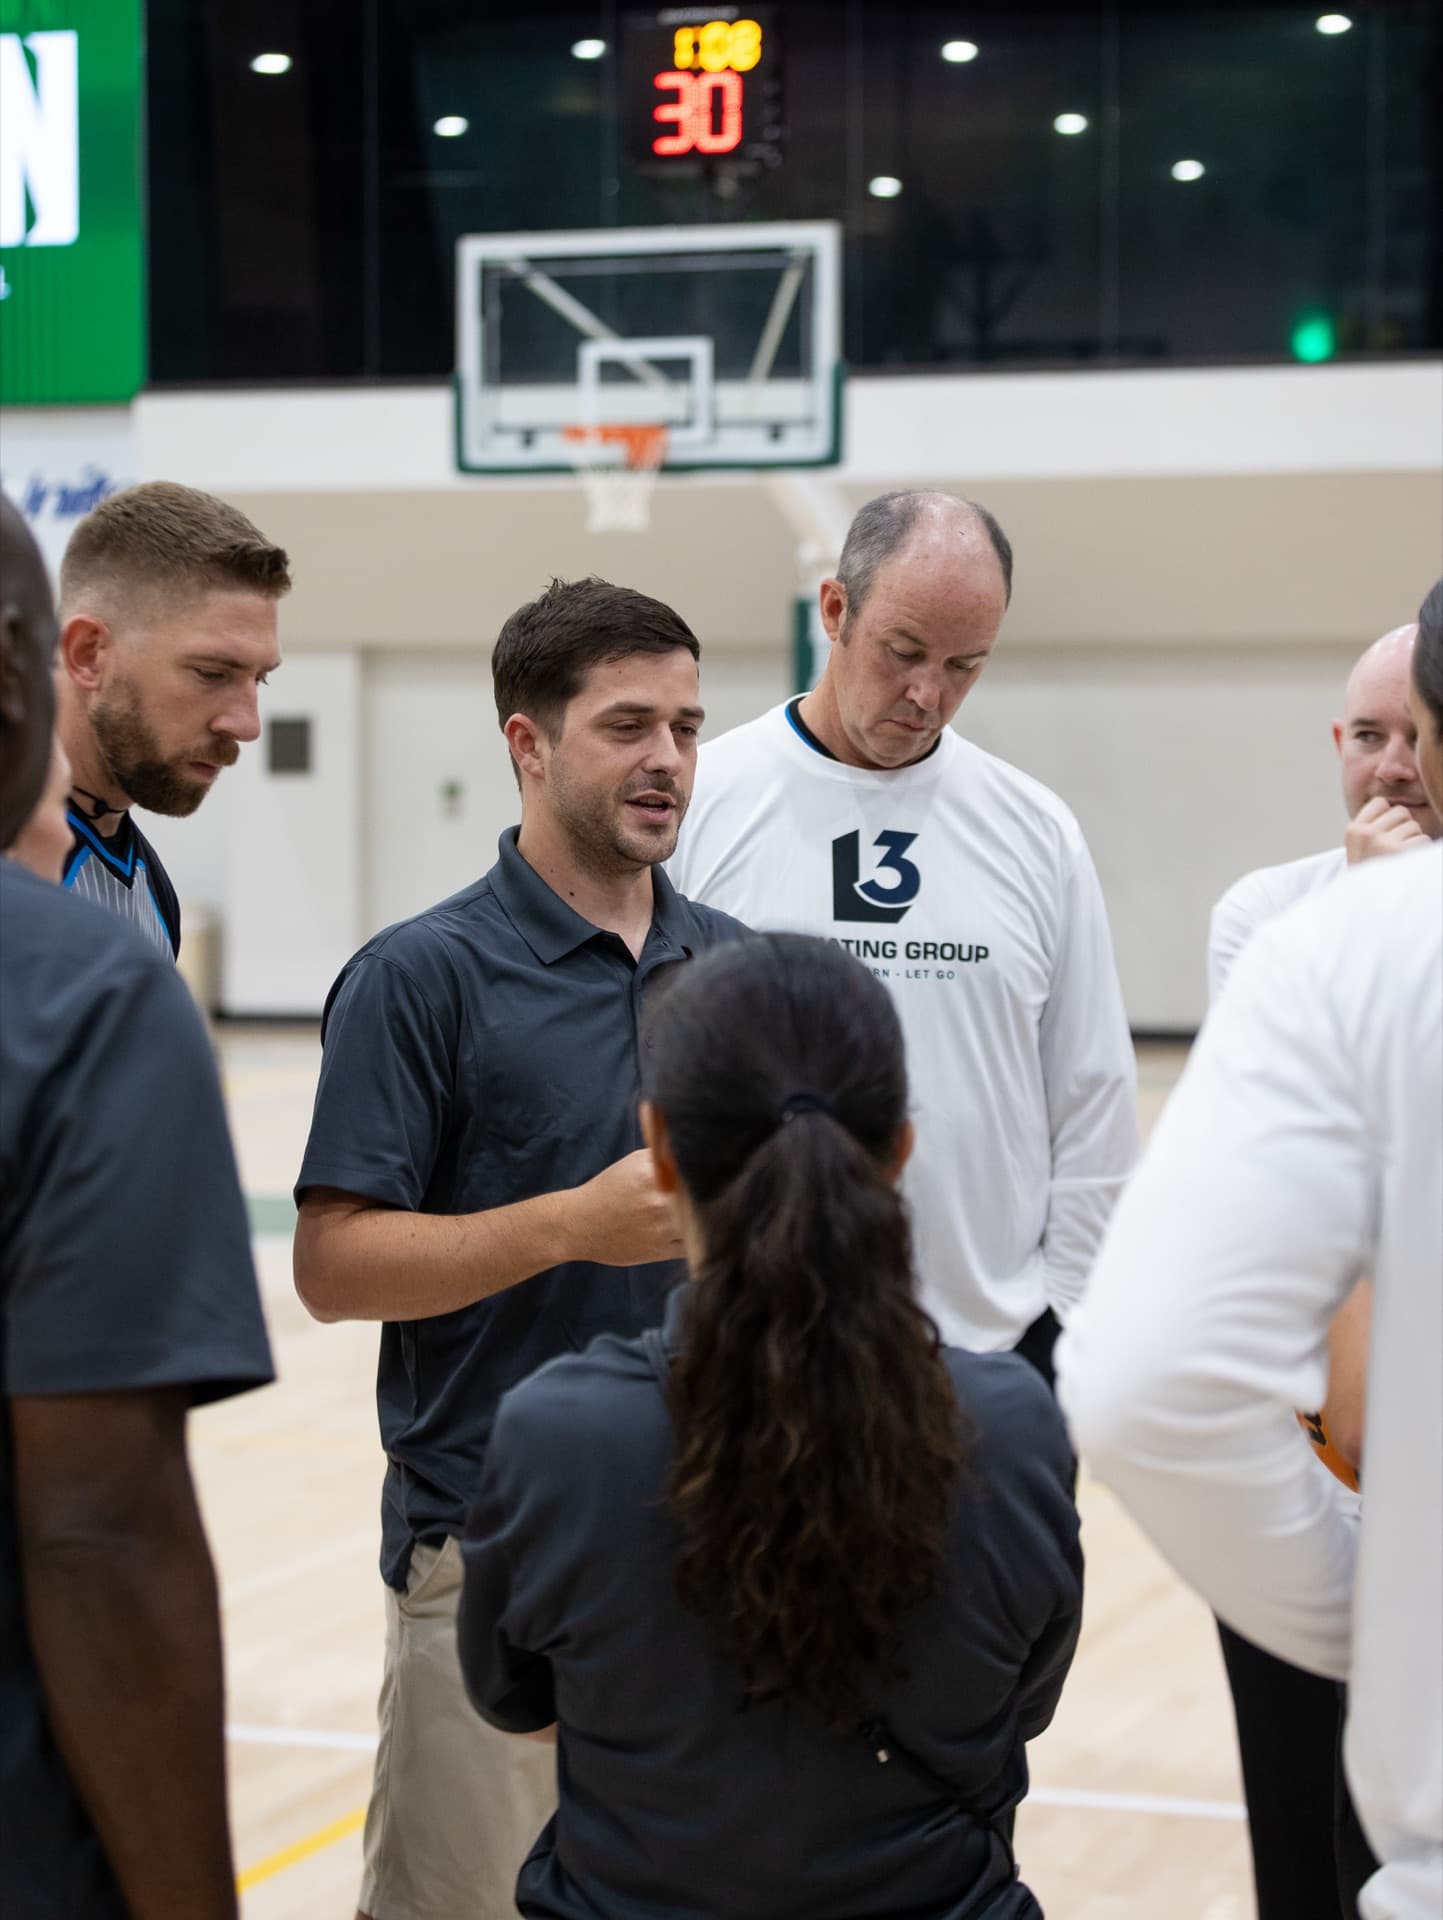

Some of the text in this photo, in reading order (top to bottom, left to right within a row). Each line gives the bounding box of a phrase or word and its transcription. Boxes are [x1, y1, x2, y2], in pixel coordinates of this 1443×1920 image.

[653, 70, 743, 155] 30
[832, 829, 920, 923] L3
[832, 938, 989, 963] TING GROUP
[872, 968, 890, 978] RN
[905, 969, 929, 979] LET
[936, 970, 955, 980] GO
